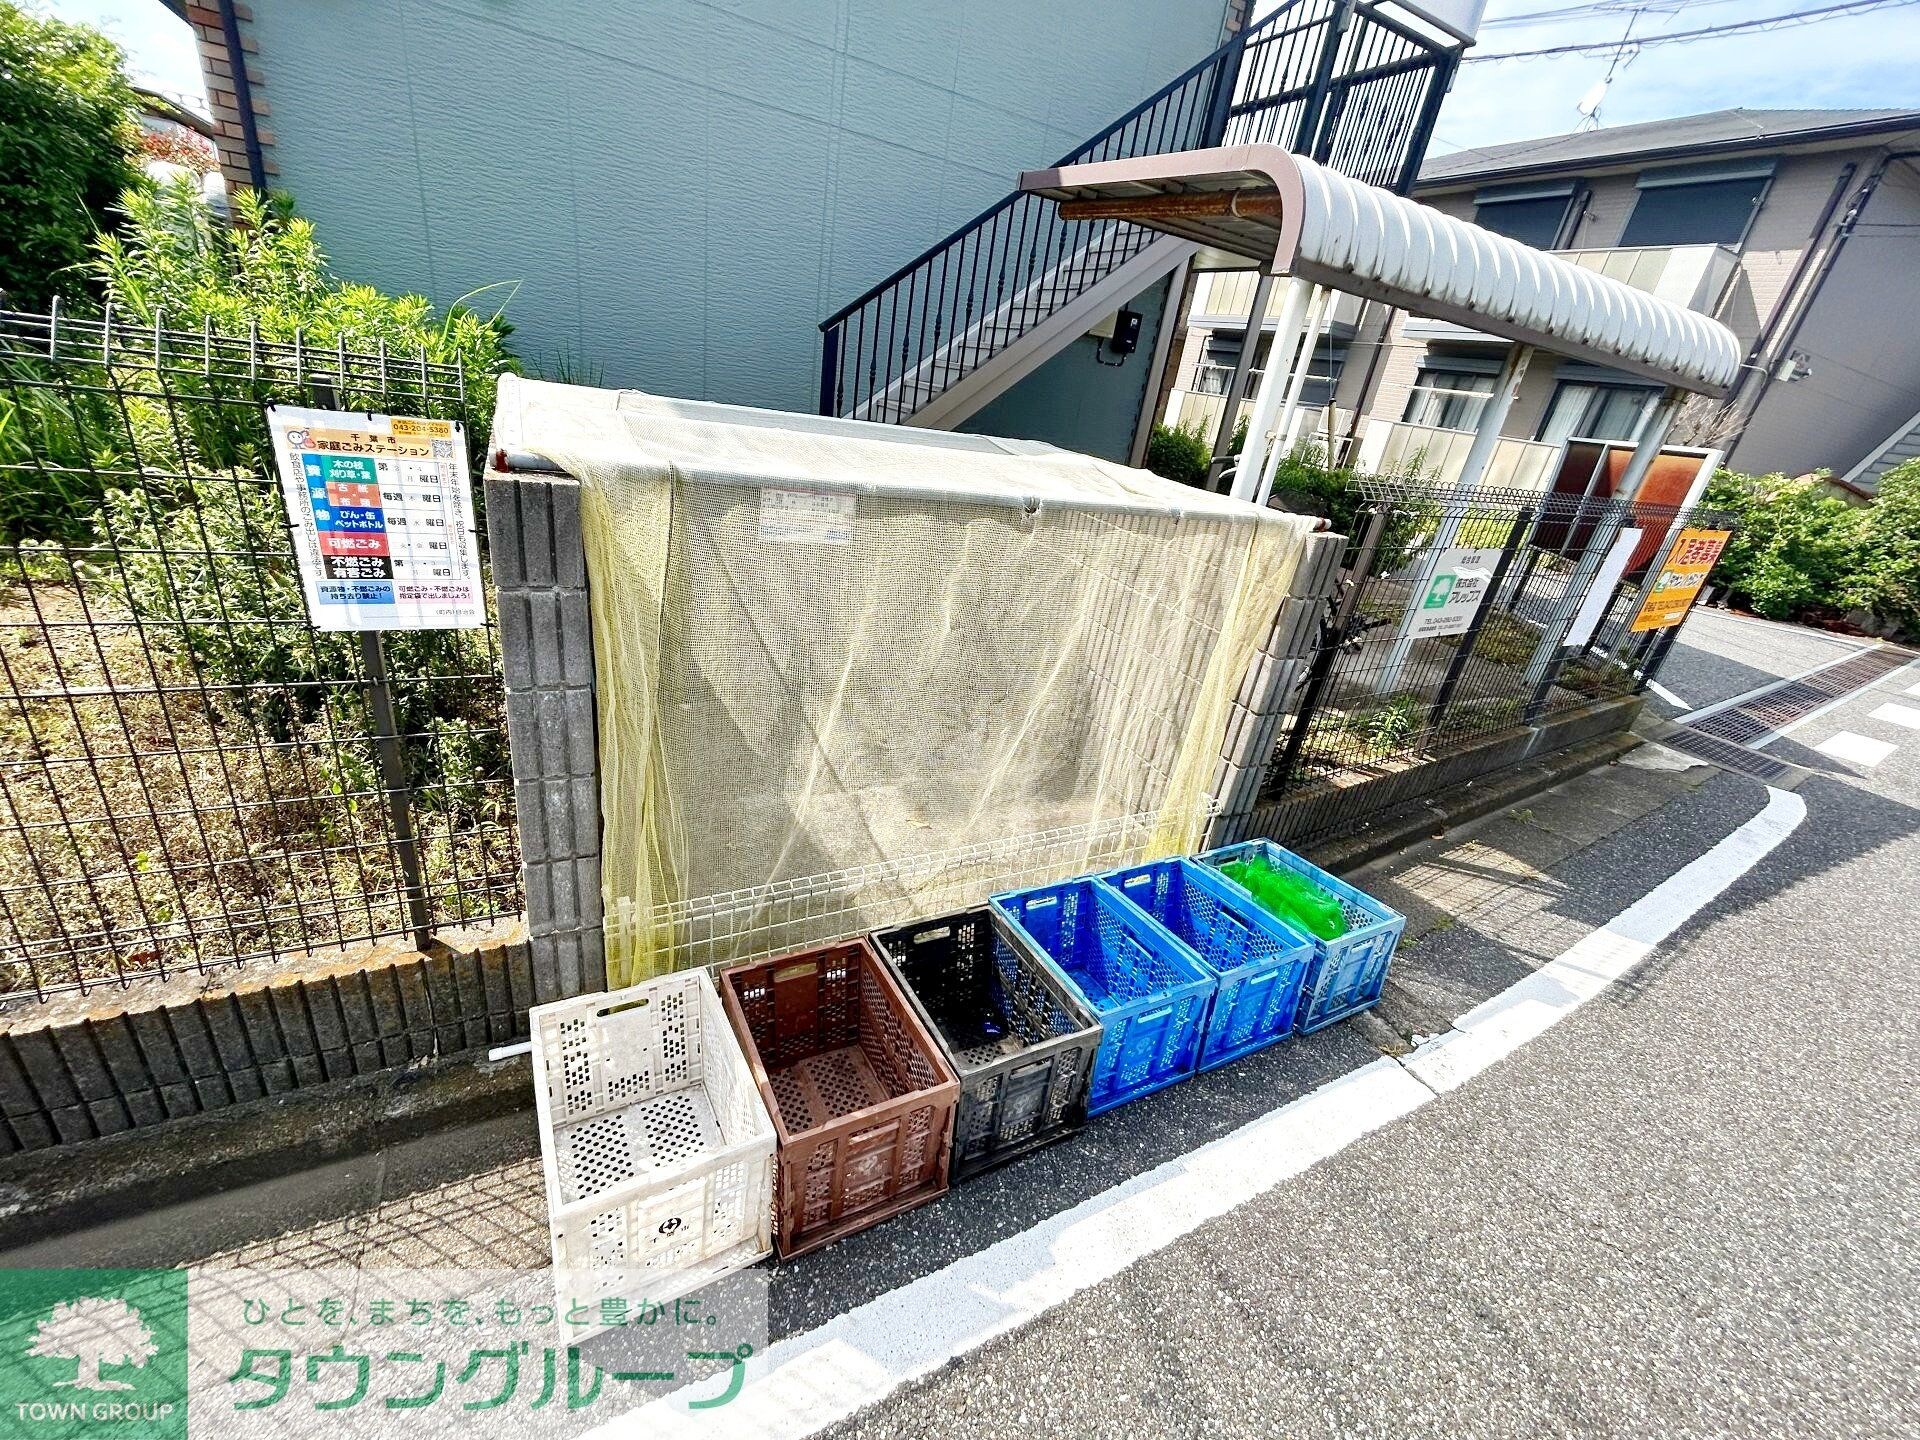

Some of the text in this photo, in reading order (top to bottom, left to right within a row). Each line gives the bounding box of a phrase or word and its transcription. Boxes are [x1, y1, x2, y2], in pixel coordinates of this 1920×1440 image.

[350, 433, 396, 443] 千葉市
[317, 440, 429, 456] 家庭ごみステーション
[332, 459, 364, 469] 木の枝
[419, 475, 438, 483] 曜日
[382, 492, 403, 501] 毎週
[422, 494, 441, 502] 曜日
[339, 510, 375, 519] びん・缶
[334, 519, 383, 528] ペットボトル
[387, 517, 406, 525] 毎週
[425, 518, 444, 526] 曜日
[327, 537, 381, 548] 可燃ごみ
[1668, 539, 1723, 565] 入居者募集
[331, 556, 384, 566] 不燃ごみ
[332, 567, 386, 578] 有害ごみ
[432, 568, 450, 576] 曜日
